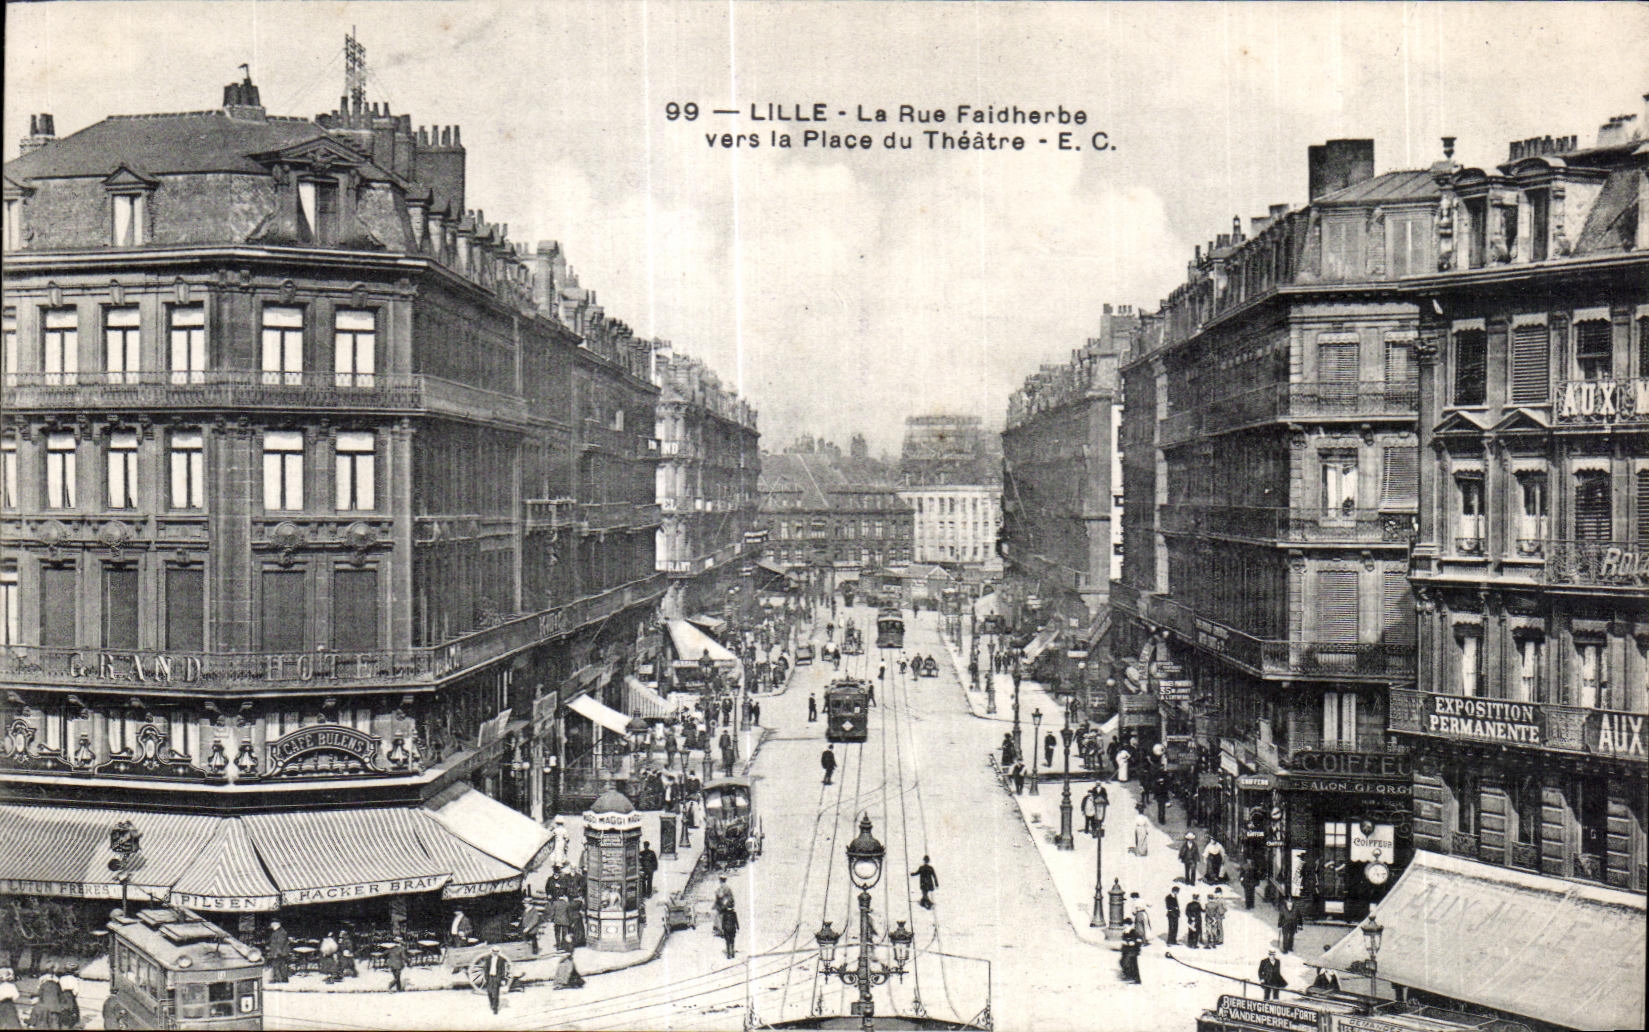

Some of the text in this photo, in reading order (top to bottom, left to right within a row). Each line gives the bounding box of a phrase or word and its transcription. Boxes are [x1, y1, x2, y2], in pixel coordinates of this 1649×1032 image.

[1562, 382, 1617, 416] AUX
[70, 653, 202, 683] GRAND
[1434, 696, 1534, 723] EXPOSITION
[1429, 714, 1540, 744] PERMANENTE
[1598, 713, 1645, 756] AUX
[318, 732, 365, 753] BULENS
[1301, 780, 1348, 791] SALON
[598, 816, 625, 826] MAGGI
[1353, 837, 1393, 849] COIFFEUR
[182, 895, 257, 909] PILSEN
[299, 884, 380, 901] HACKER
[1294, 1007, 1317, 1022] FORTE
